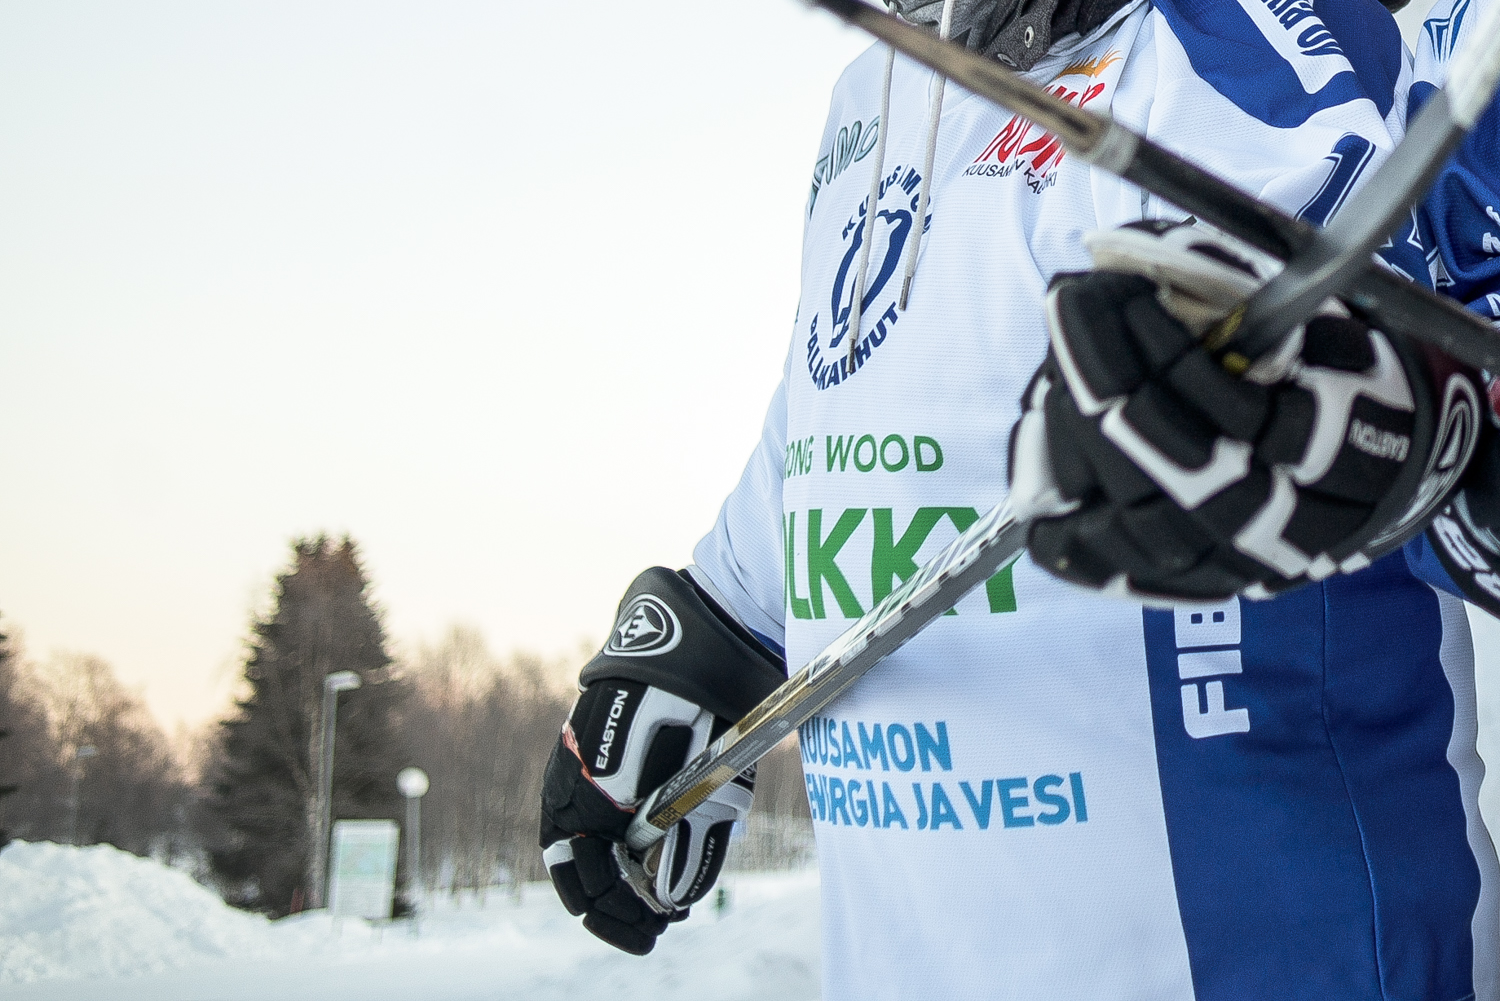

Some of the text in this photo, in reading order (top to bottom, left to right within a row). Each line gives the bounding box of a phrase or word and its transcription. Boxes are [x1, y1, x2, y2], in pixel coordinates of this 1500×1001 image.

[826, 433, 944, 474] WOOD
[595, 689, 629, 770] EASTON
[805, 772, 909, 830] ENRGIA
